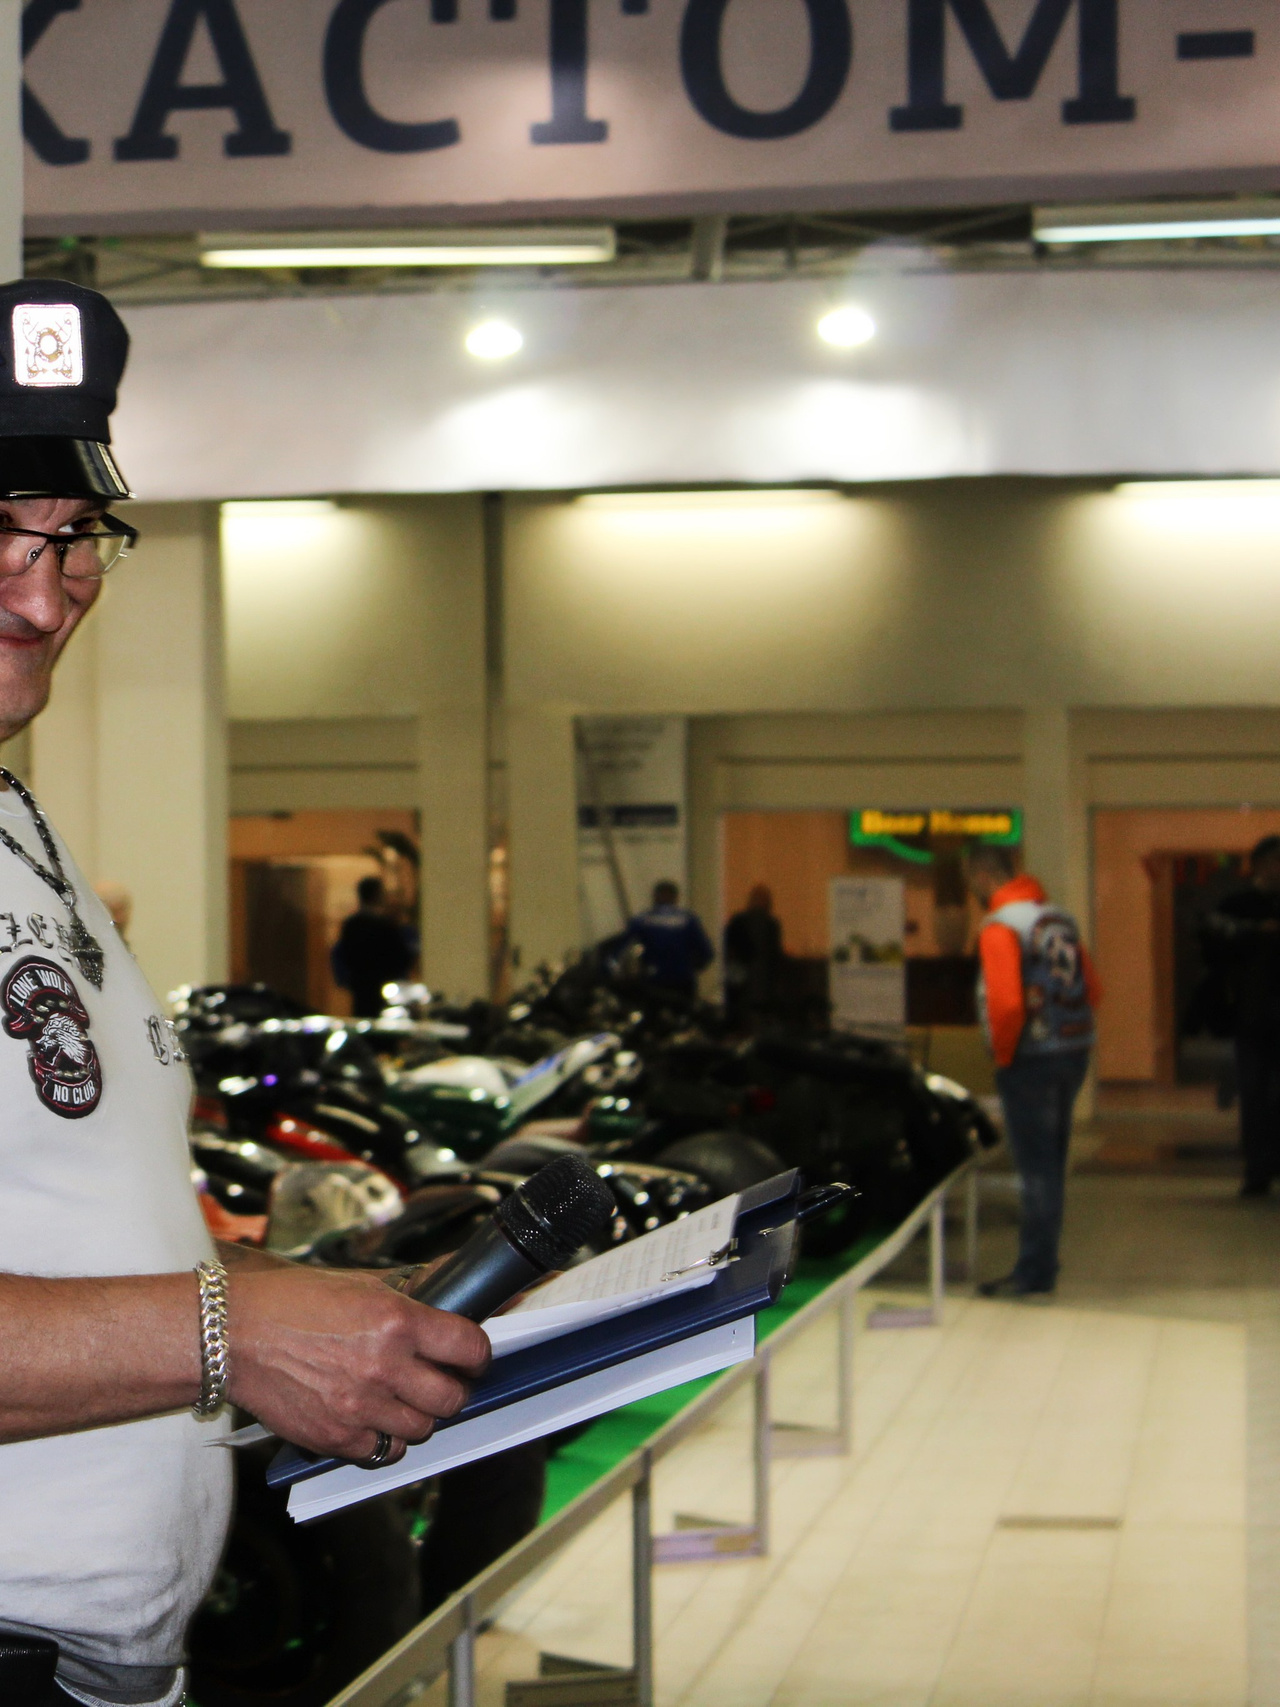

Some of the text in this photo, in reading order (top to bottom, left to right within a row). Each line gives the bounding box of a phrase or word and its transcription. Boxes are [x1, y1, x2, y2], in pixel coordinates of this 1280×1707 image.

[9, 969, 72, 1008] LONE WOLF
[52, 1079, 97, 1105] NO CLUB
